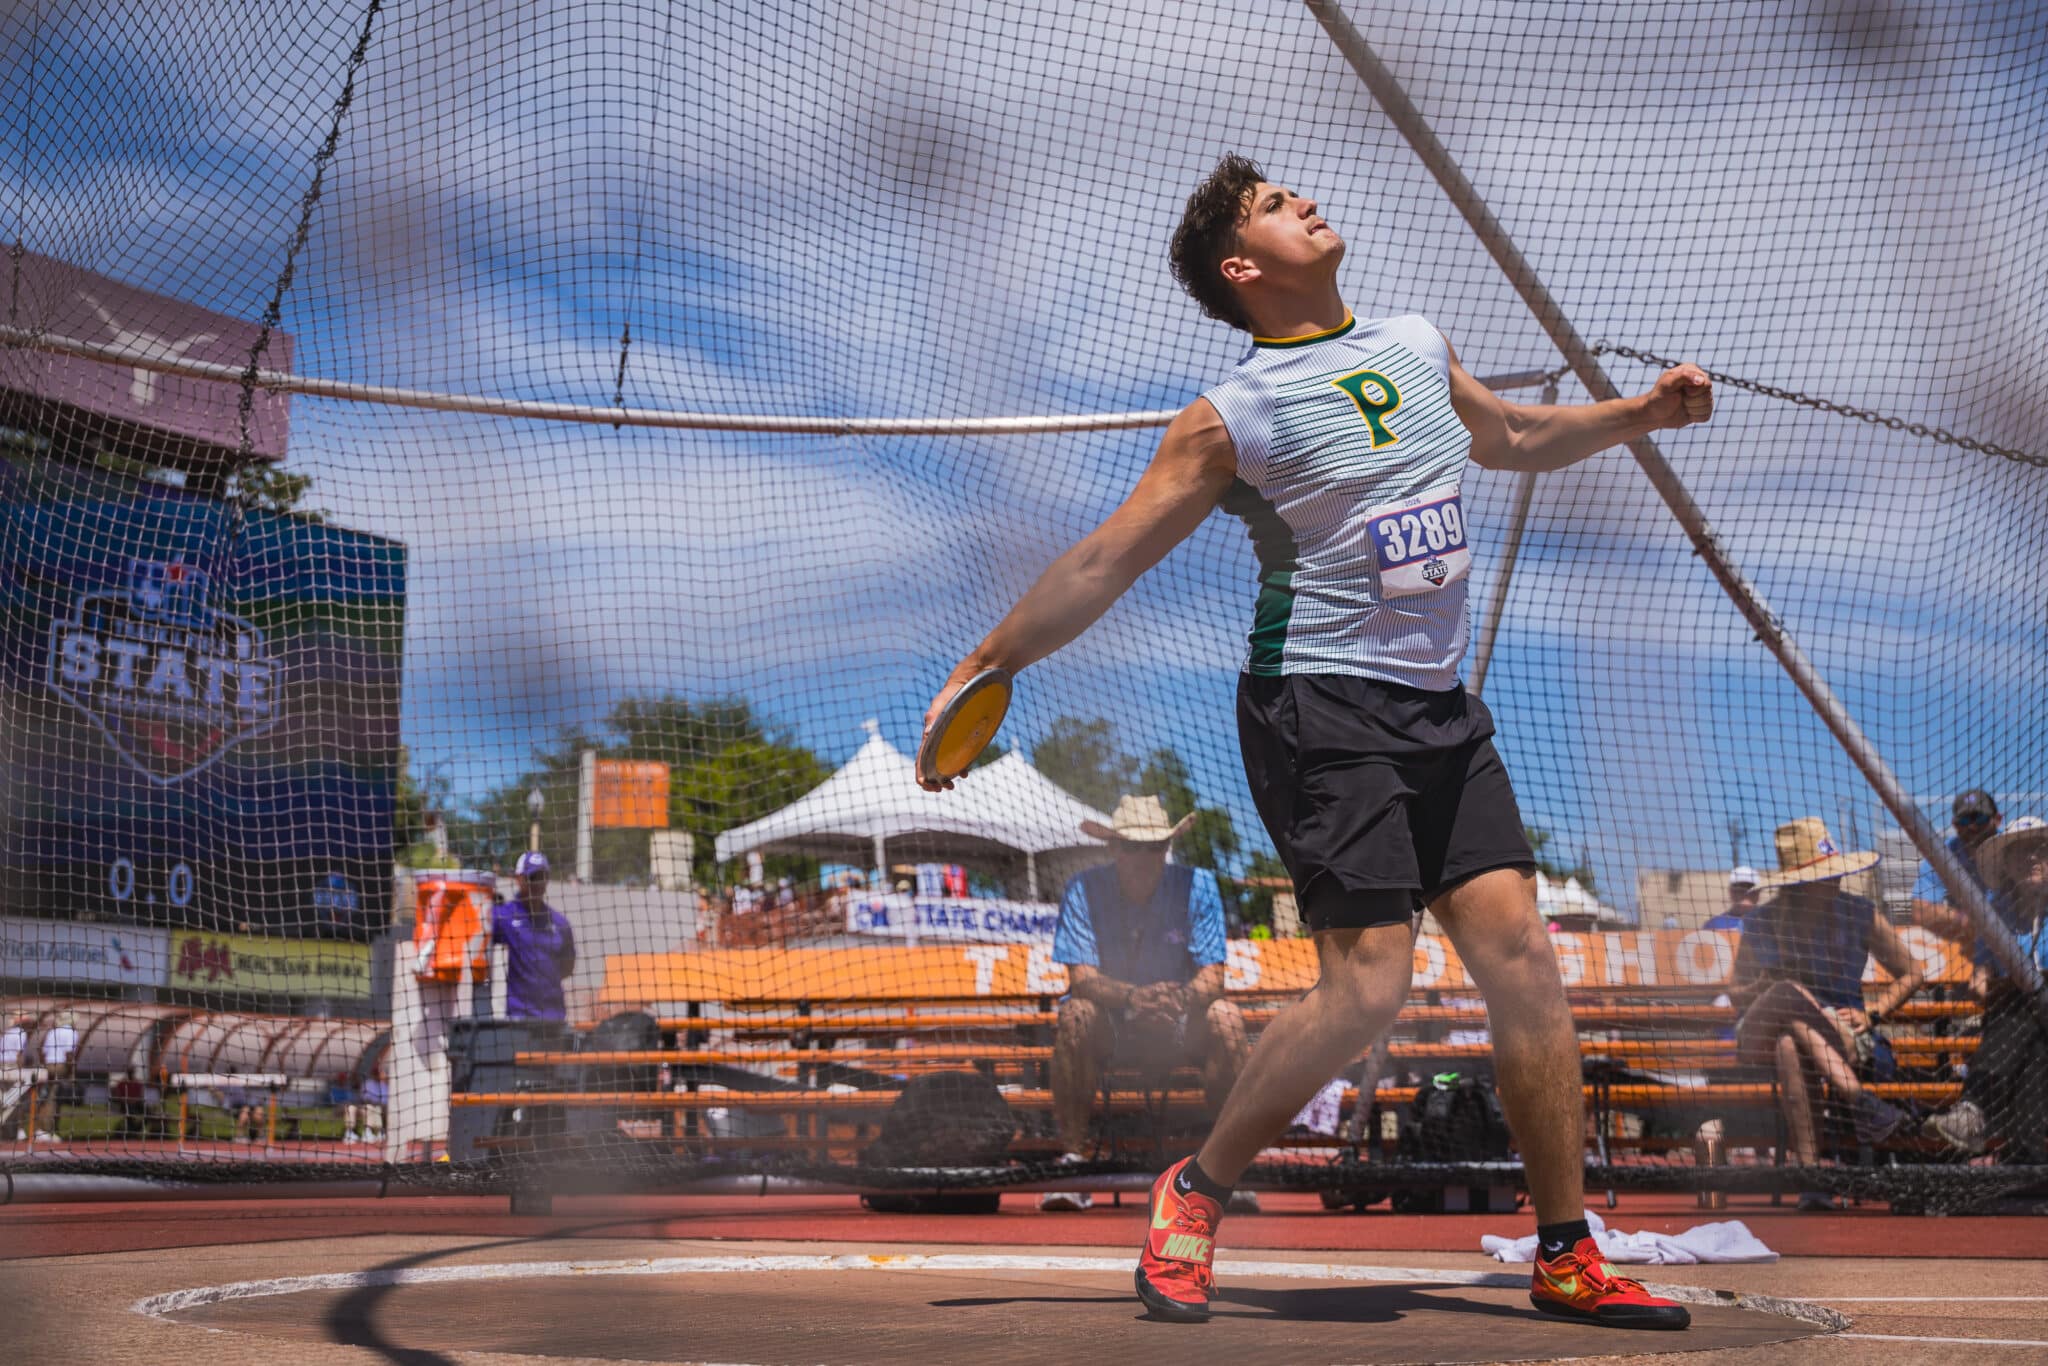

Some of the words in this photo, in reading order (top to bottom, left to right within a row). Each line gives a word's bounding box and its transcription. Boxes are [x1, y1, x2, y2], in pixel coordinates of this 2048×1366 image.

[1331, 369, 1402, 449] P
[1378, 503, 1463, 562] 3289
[1423, 565, 1448, 578] STATE
[62, 632, 272, 714] STATE
[964, 939, 1262, 994] TES
[1161, 1233, 1212, 1262] NIKE
